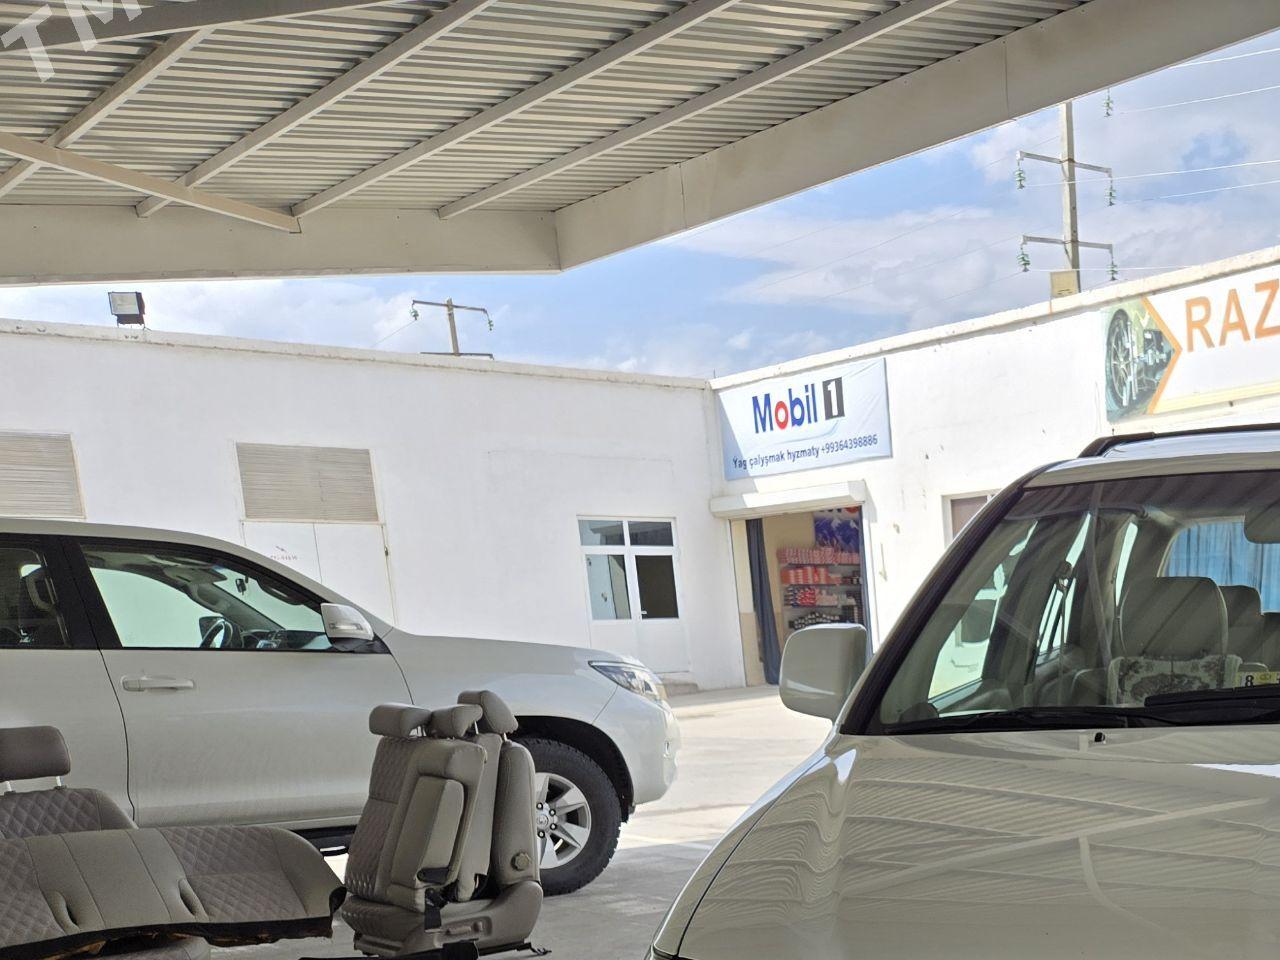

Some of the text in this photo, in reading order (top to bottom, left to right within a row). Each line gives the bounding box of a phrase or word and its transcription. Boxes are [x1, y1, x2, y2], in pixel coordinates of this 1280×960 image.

[752, 378, 842, 434] Mobil 1
[787, 445, 820, 464] hyzmaty
